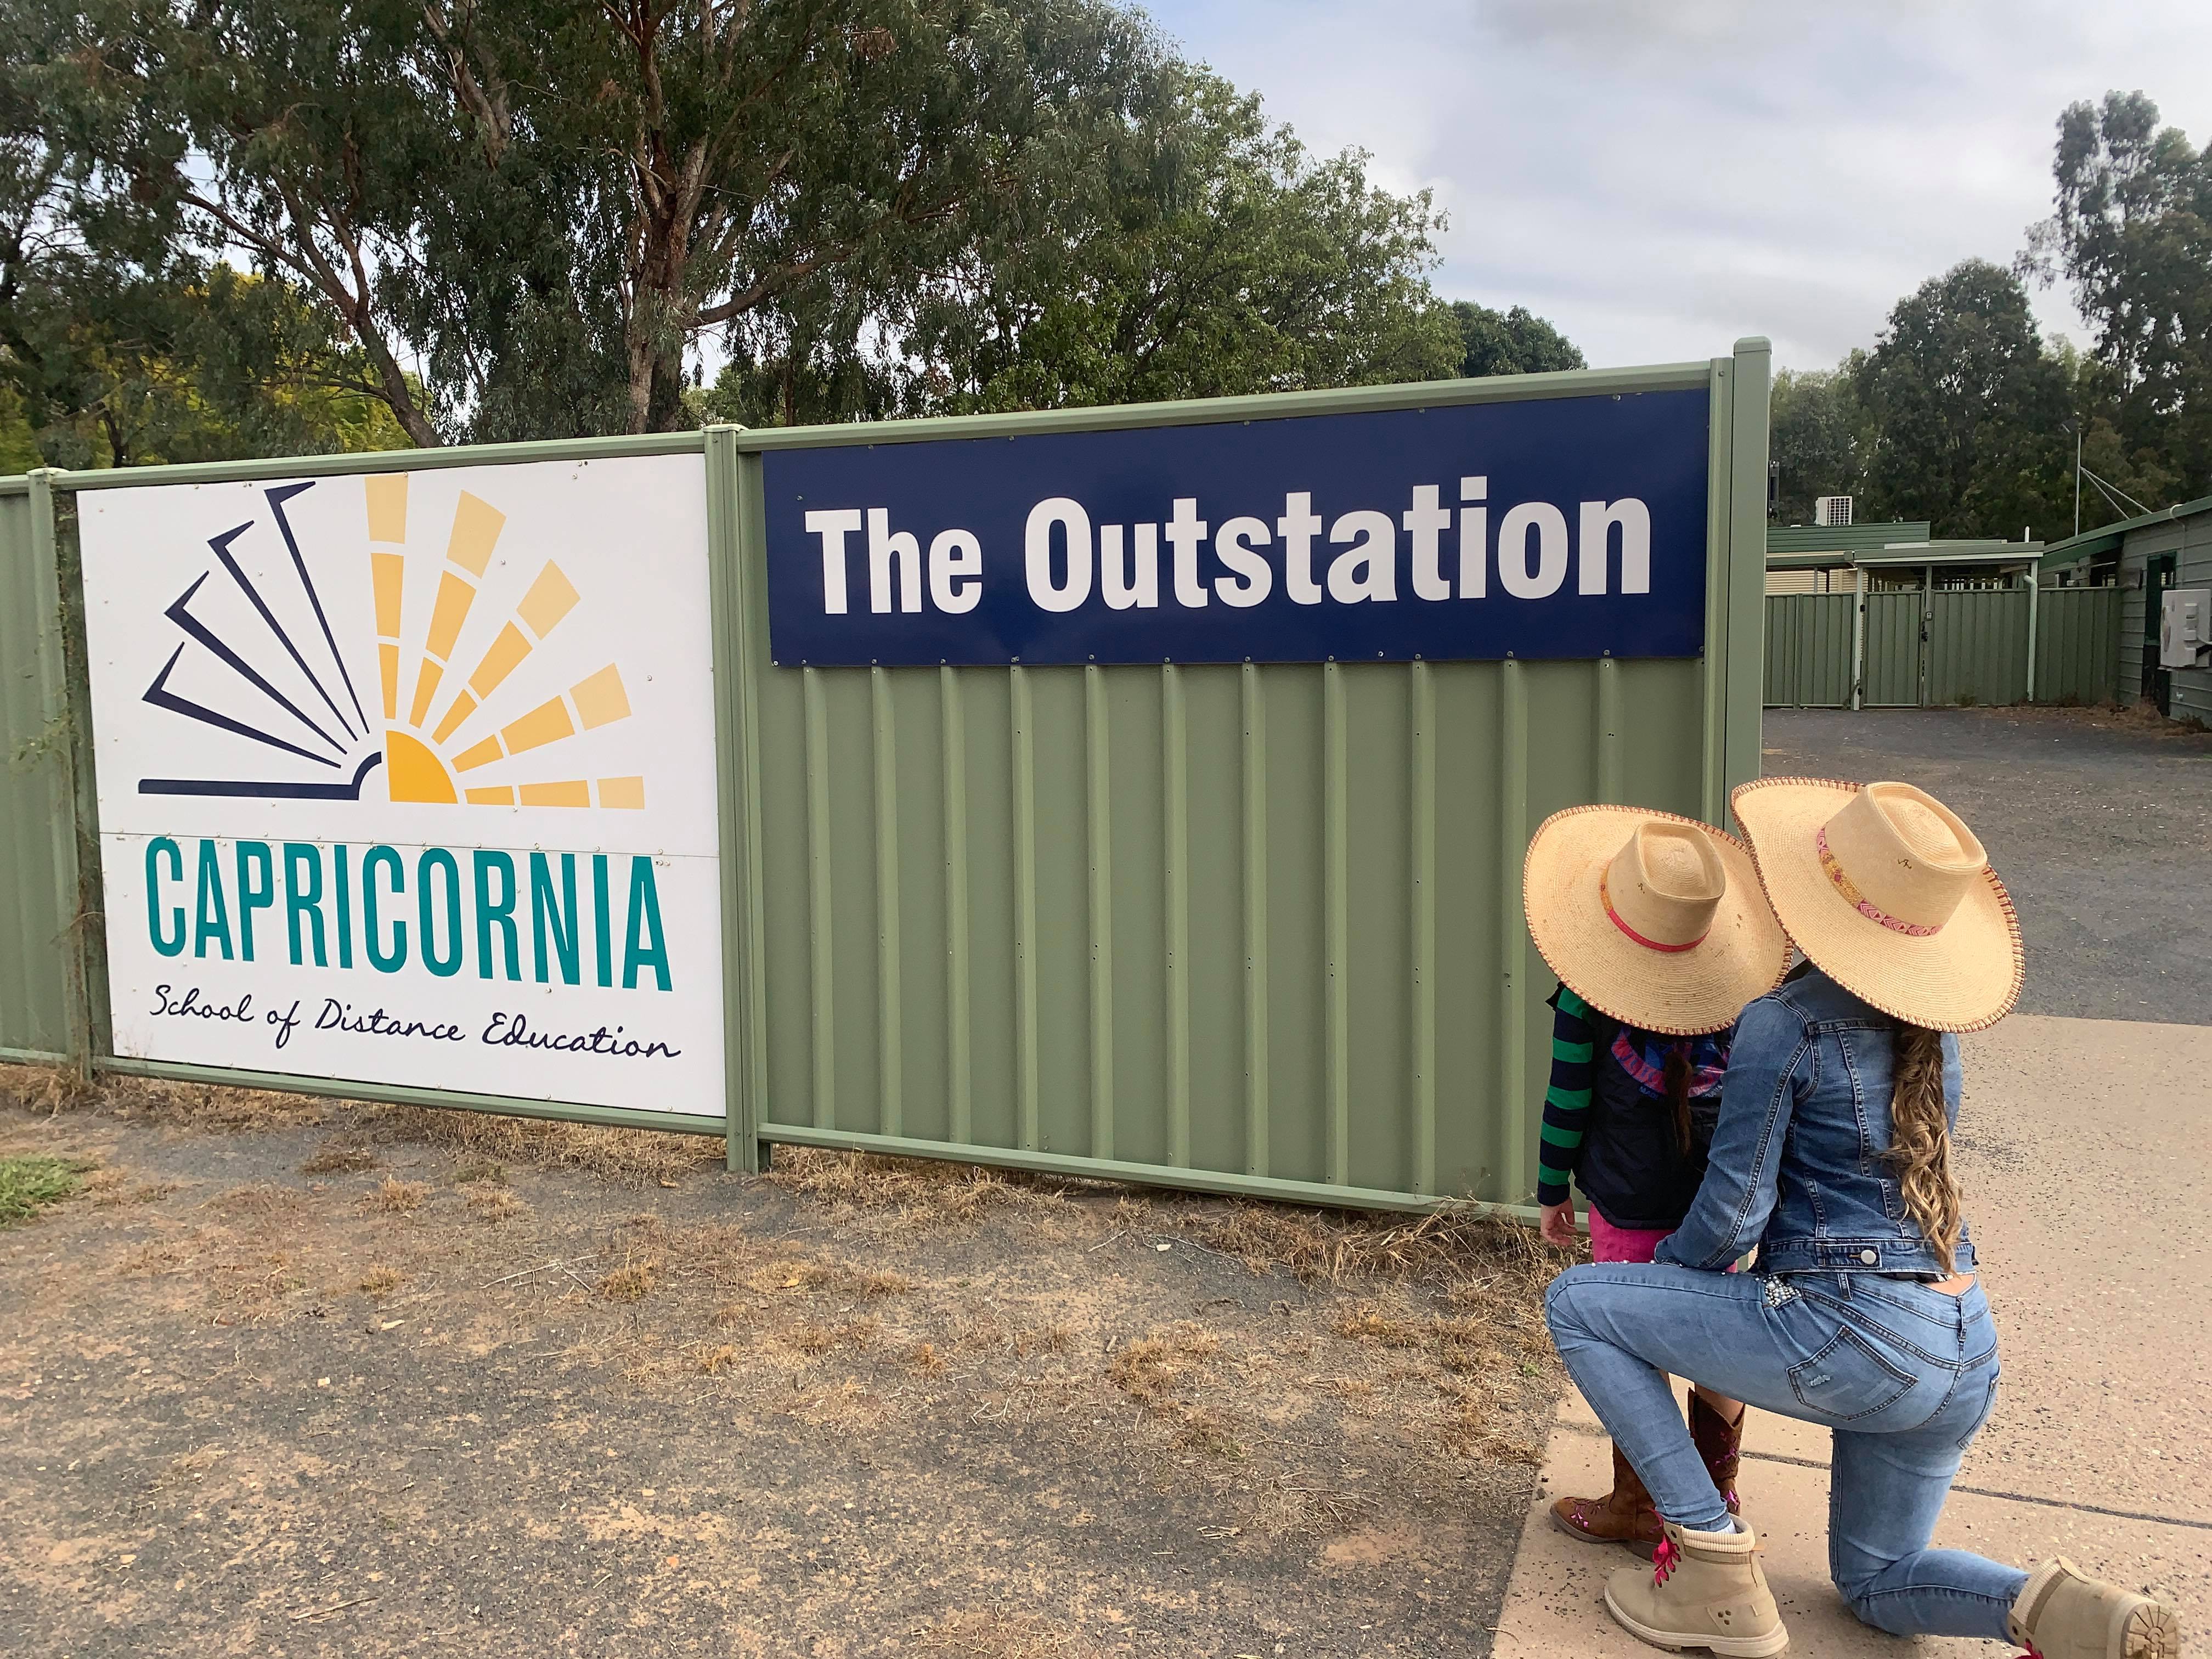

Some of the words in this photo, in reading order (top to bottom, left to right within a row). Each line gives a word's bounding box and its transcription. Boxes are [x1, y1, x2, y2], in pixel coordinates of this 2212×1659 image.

[805, 507, 983, 615] The
[1025, 476, 1651, 613] Outstation
[145, 836, 673, 992] CAPRICORNIA
[149, 984, 255, 1023] School
[267, 1000, 301, 1049] of
[314, 997, 466, 1041] Distance
[482, 1012, 682, 1058] Education
